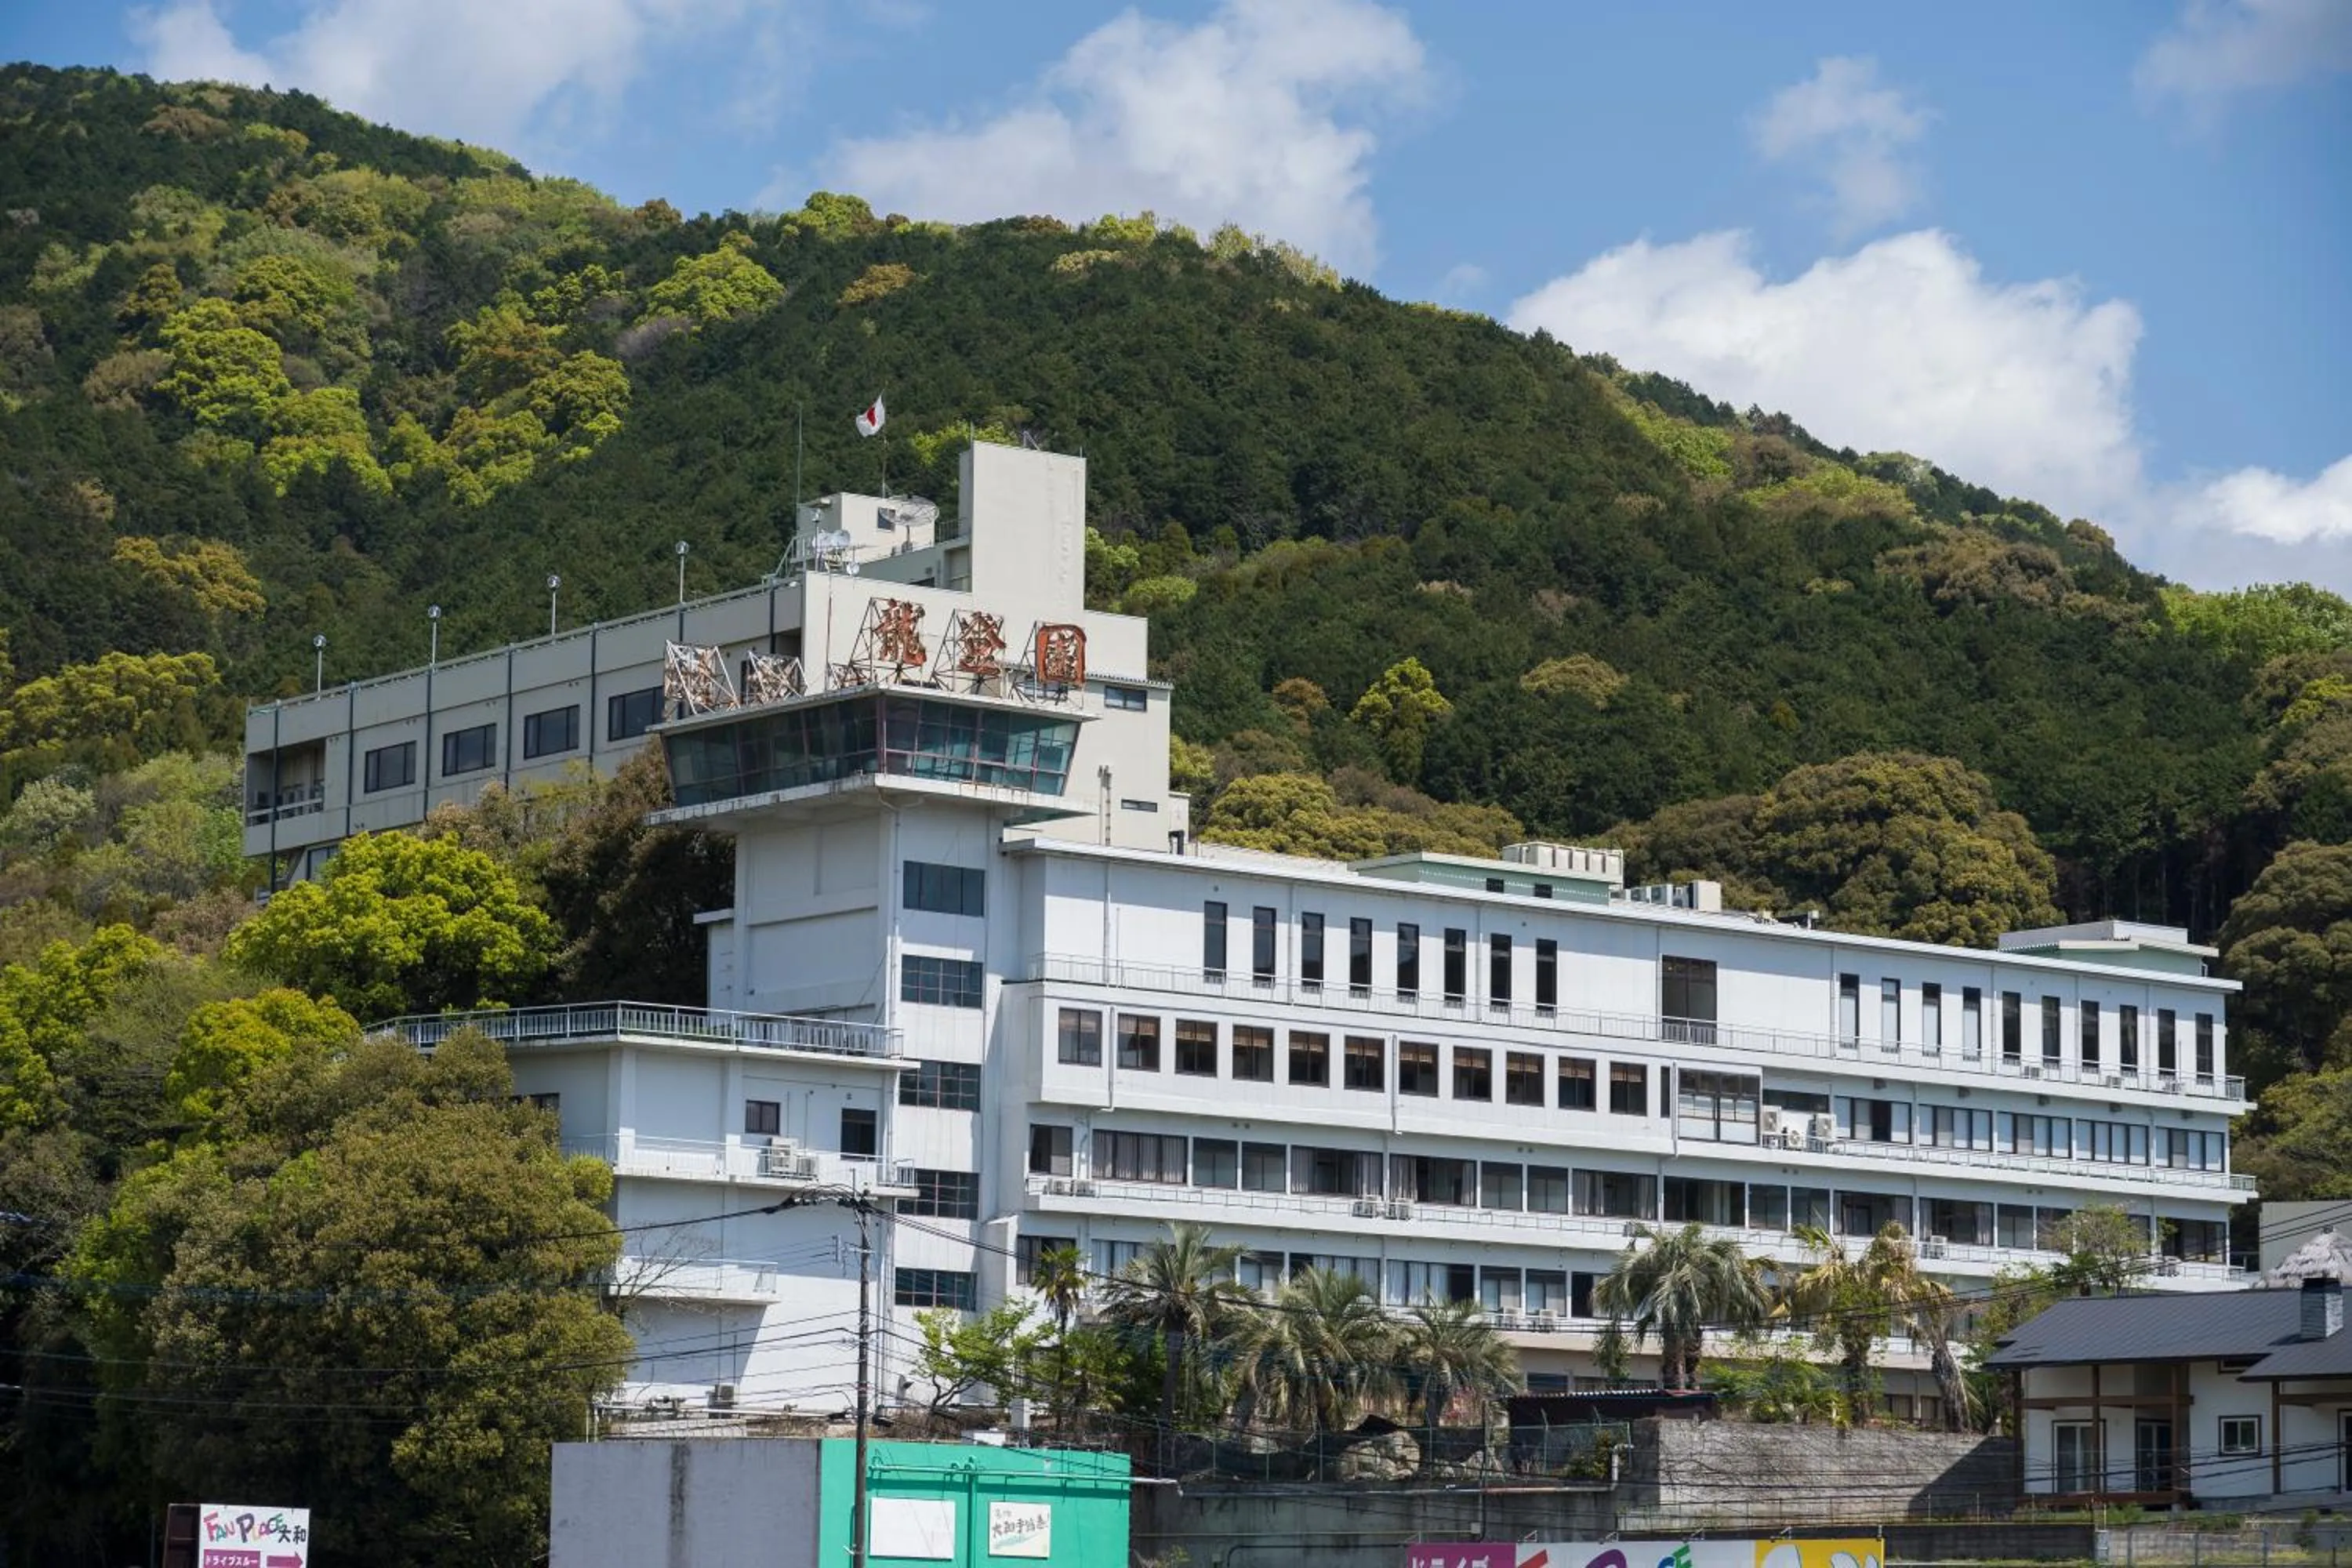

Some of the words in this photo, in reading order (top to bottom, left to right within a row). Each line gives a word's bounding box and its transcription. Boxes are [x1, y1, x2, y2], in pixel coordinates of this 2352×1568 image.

[278, 1524, 307, 1544] 大和
[205, 1555, 259, 1566] ドライブスルー
